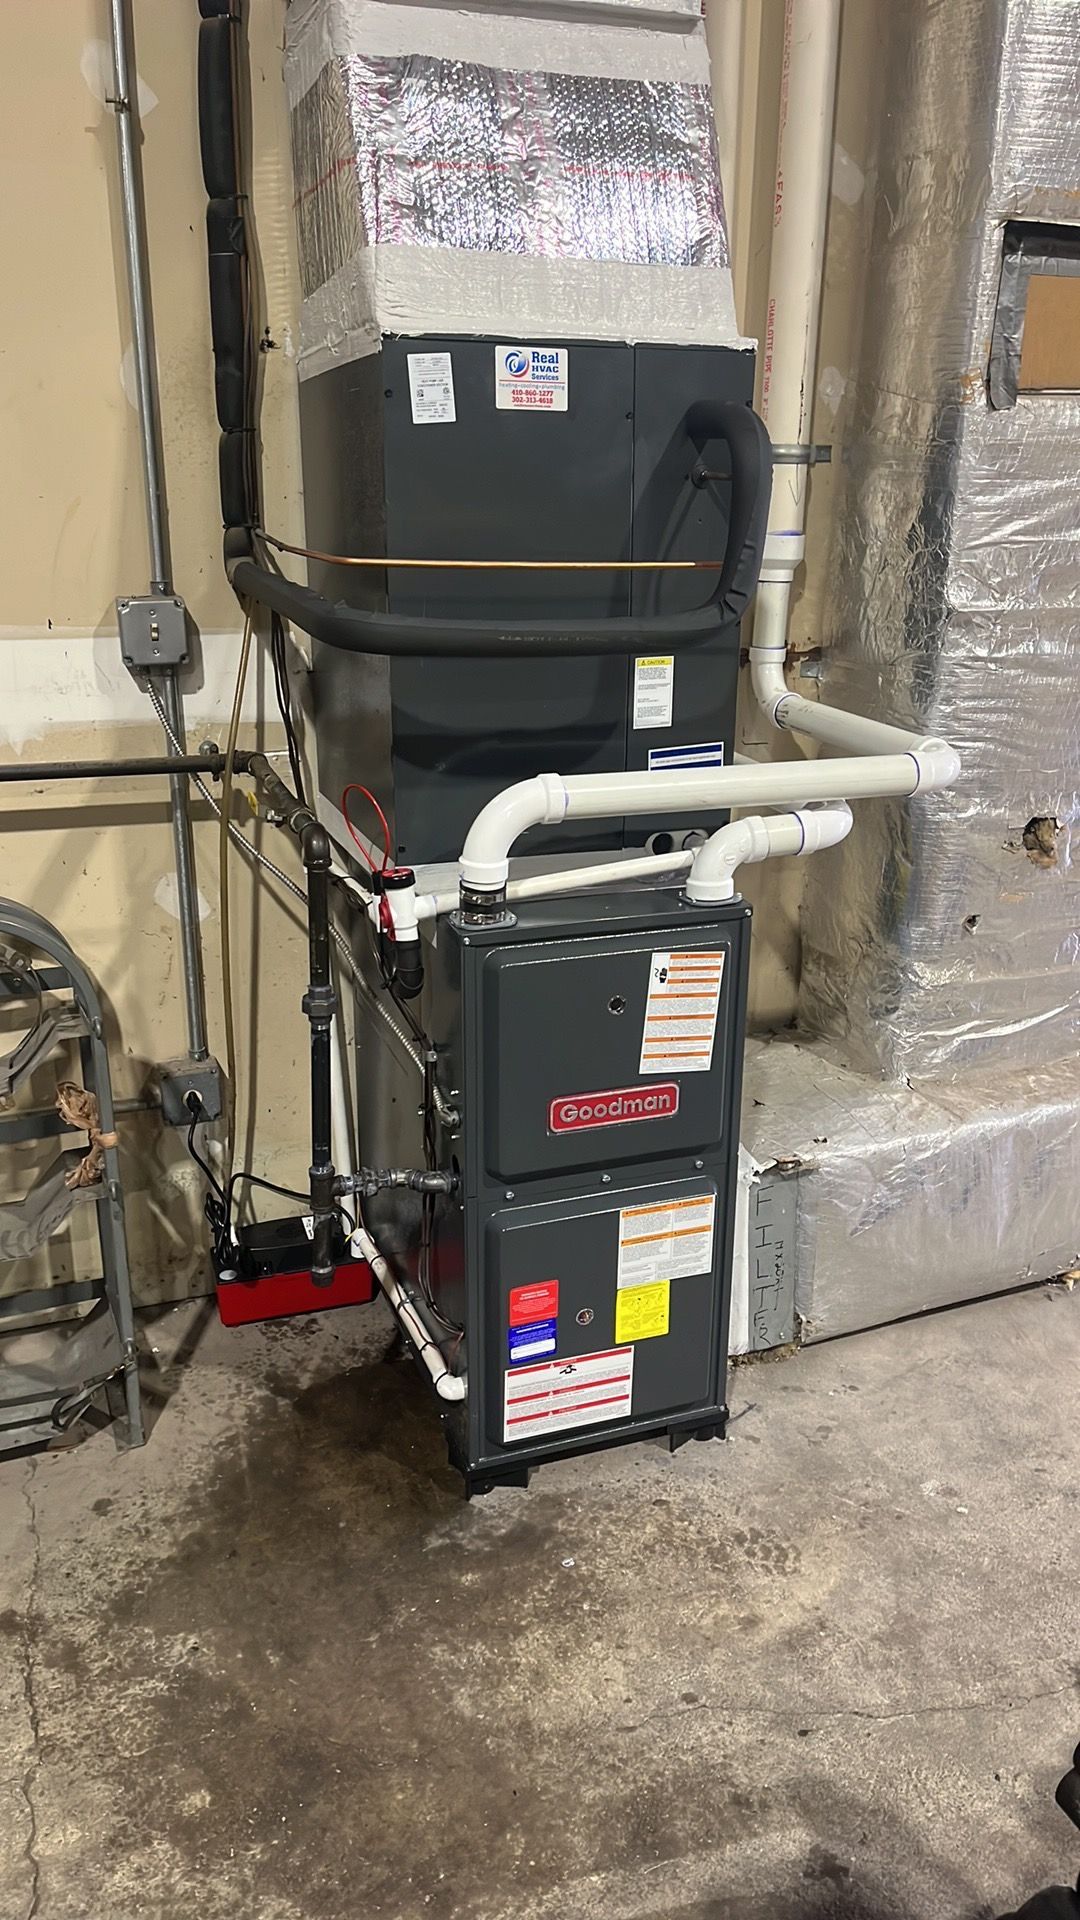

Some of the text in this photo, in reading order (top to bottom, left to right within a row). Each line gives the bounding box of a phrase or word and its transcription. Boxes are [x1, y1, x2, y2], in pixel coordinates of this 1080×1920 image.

[767, 298, 776, 352] CHARLOTTE
[531, 351, 559, 364] Real
[765, 355, 773, 373] PIPE
[531, 365, 559, 373] HVAC
[531, 373, 559, 381] Services
[560, 1094, 671, 1123] Goodman
